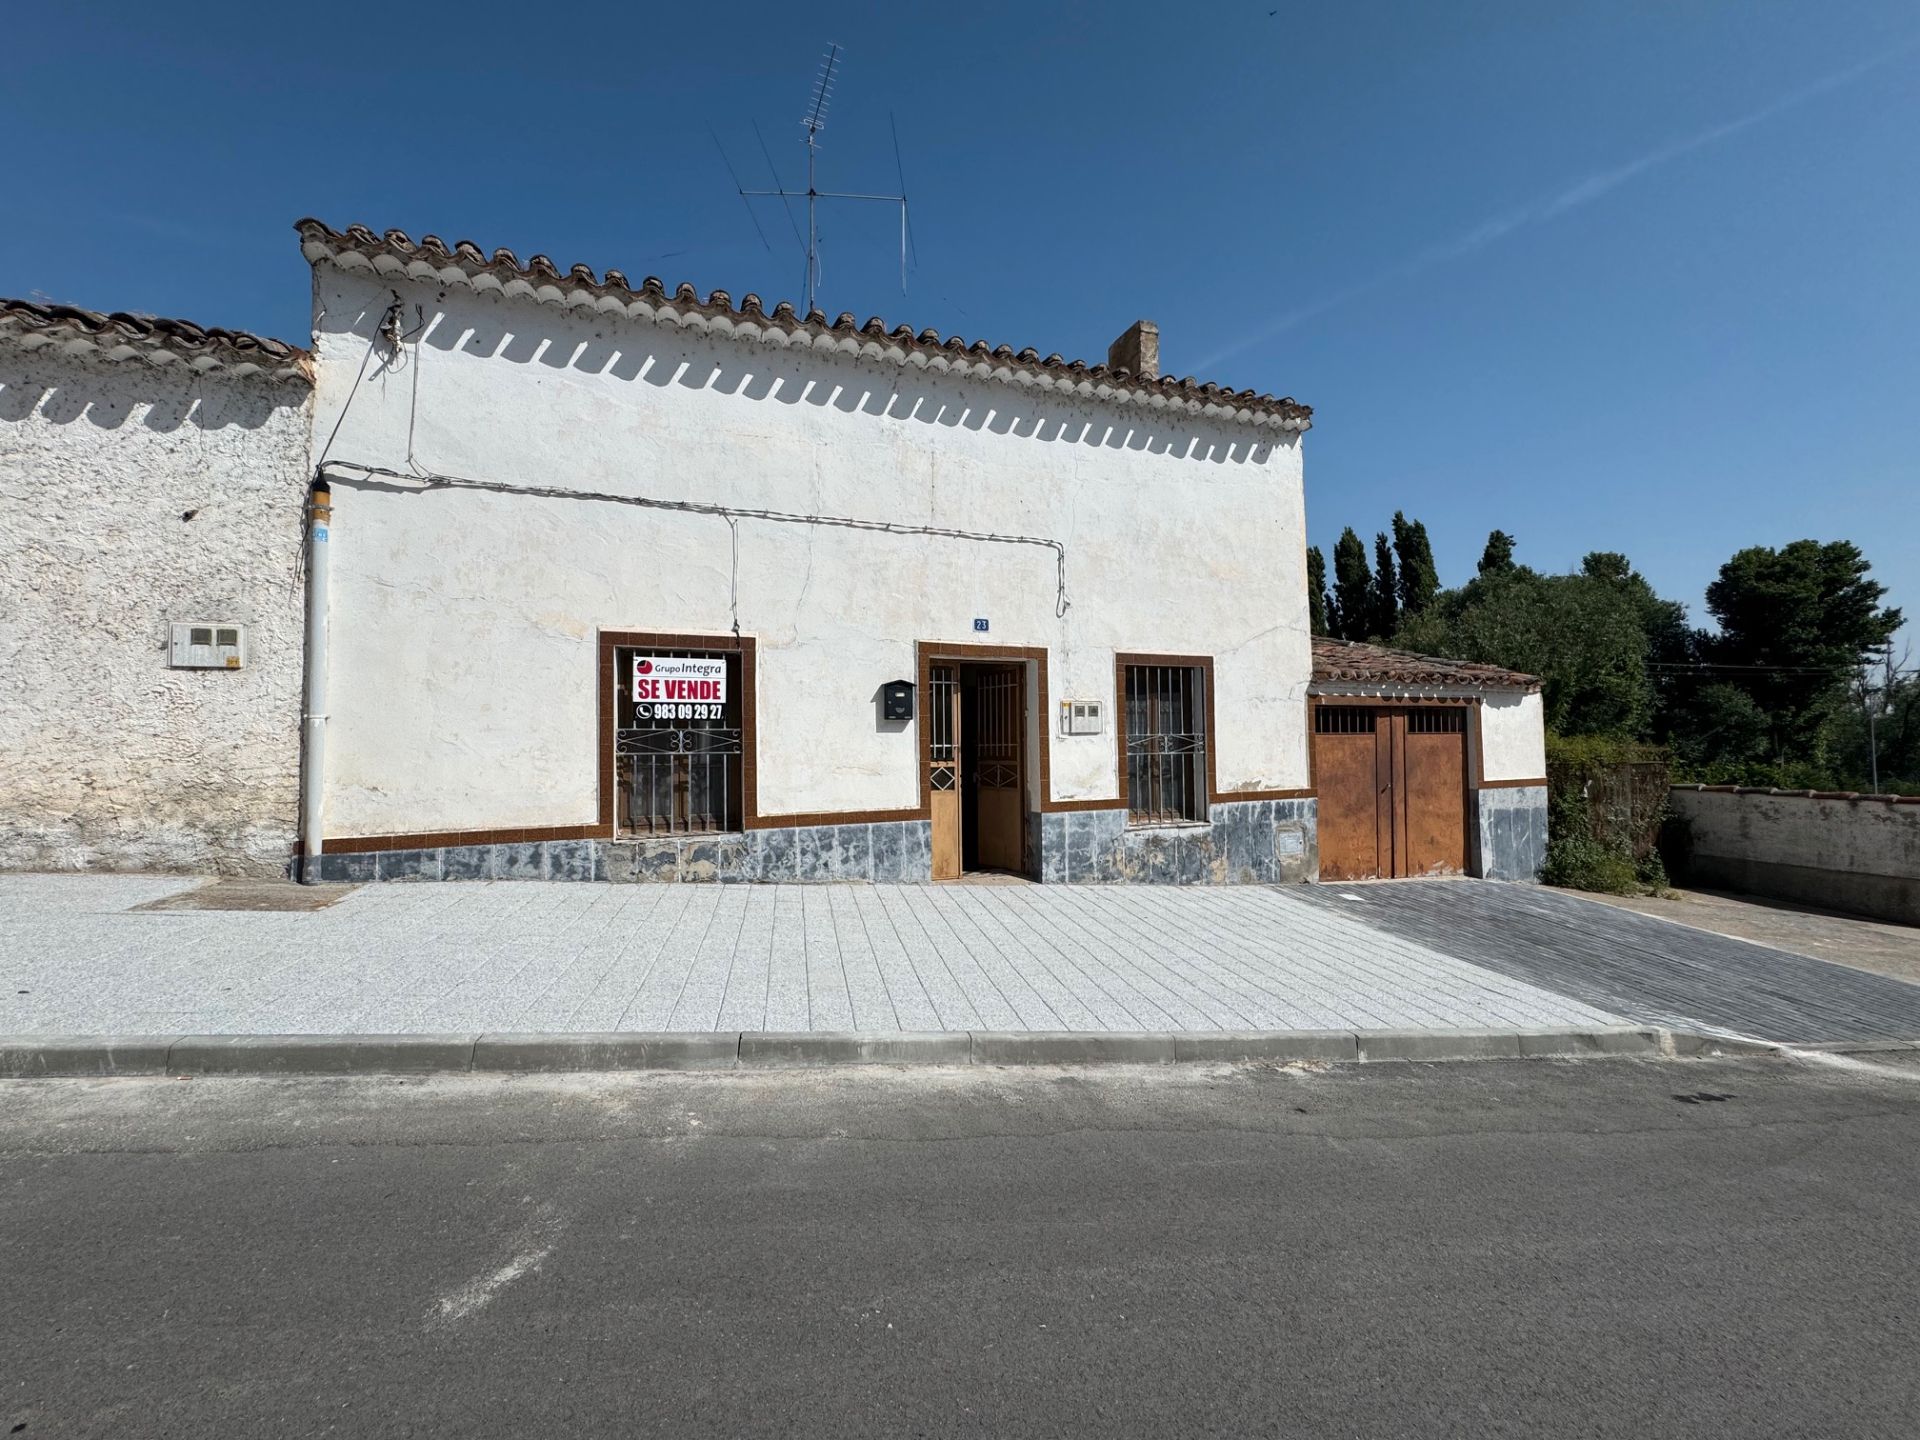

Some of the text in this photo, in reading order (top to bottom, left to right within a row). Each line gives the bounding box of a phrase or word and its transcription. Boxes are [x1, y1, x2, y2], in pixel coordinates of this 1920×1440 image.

[976, 620, 987, 630] 23
[655, 663, 722, 676] Grupo Integra
[638, 679, 721, 700] SE VENDE
[654, 704, 722, 719] 983 09 29 27
